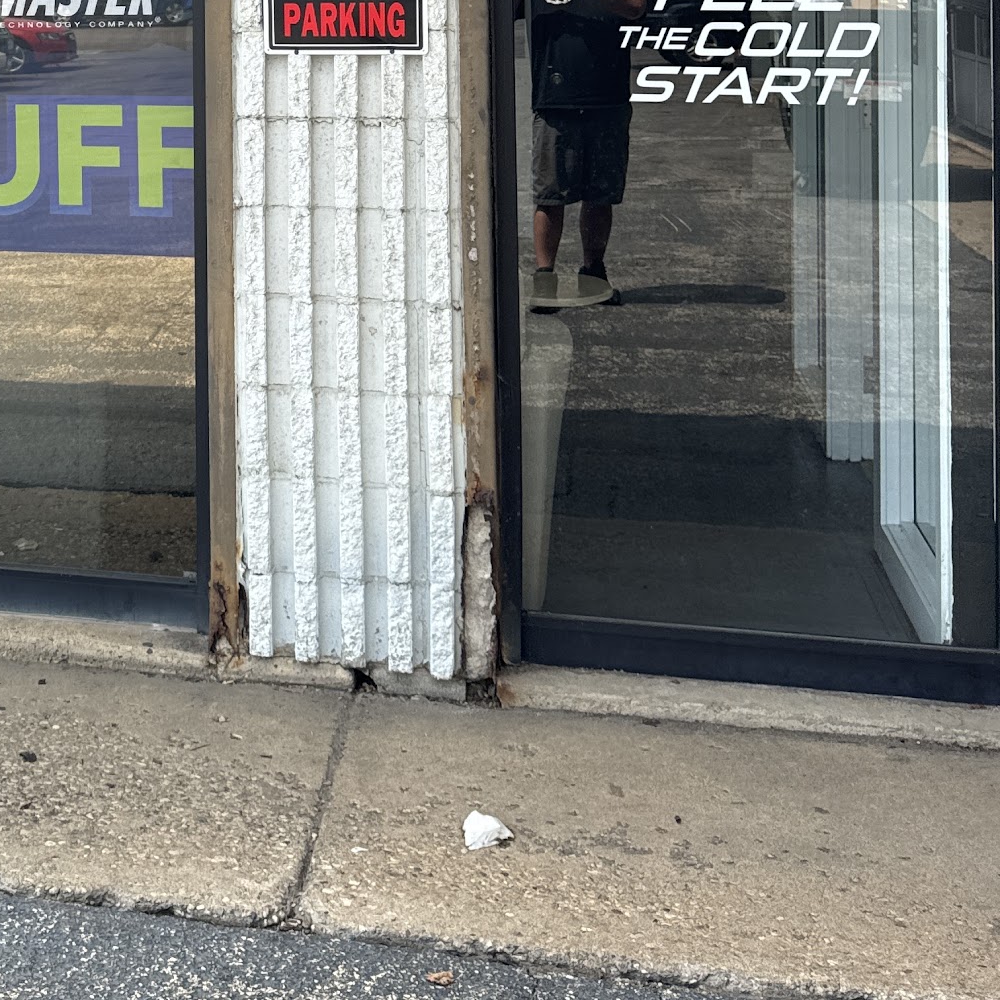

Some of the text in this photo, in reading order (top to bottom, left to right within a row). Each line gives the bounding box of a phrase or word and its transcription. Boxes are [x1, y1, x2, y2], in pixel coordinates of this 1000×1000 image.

[89, 19, 154, 28] COMPANY
[283, 2, 406, 38] PARKING
[618, 21, 881, 57] THE COLD
[629, 66, 870, 106] START!
